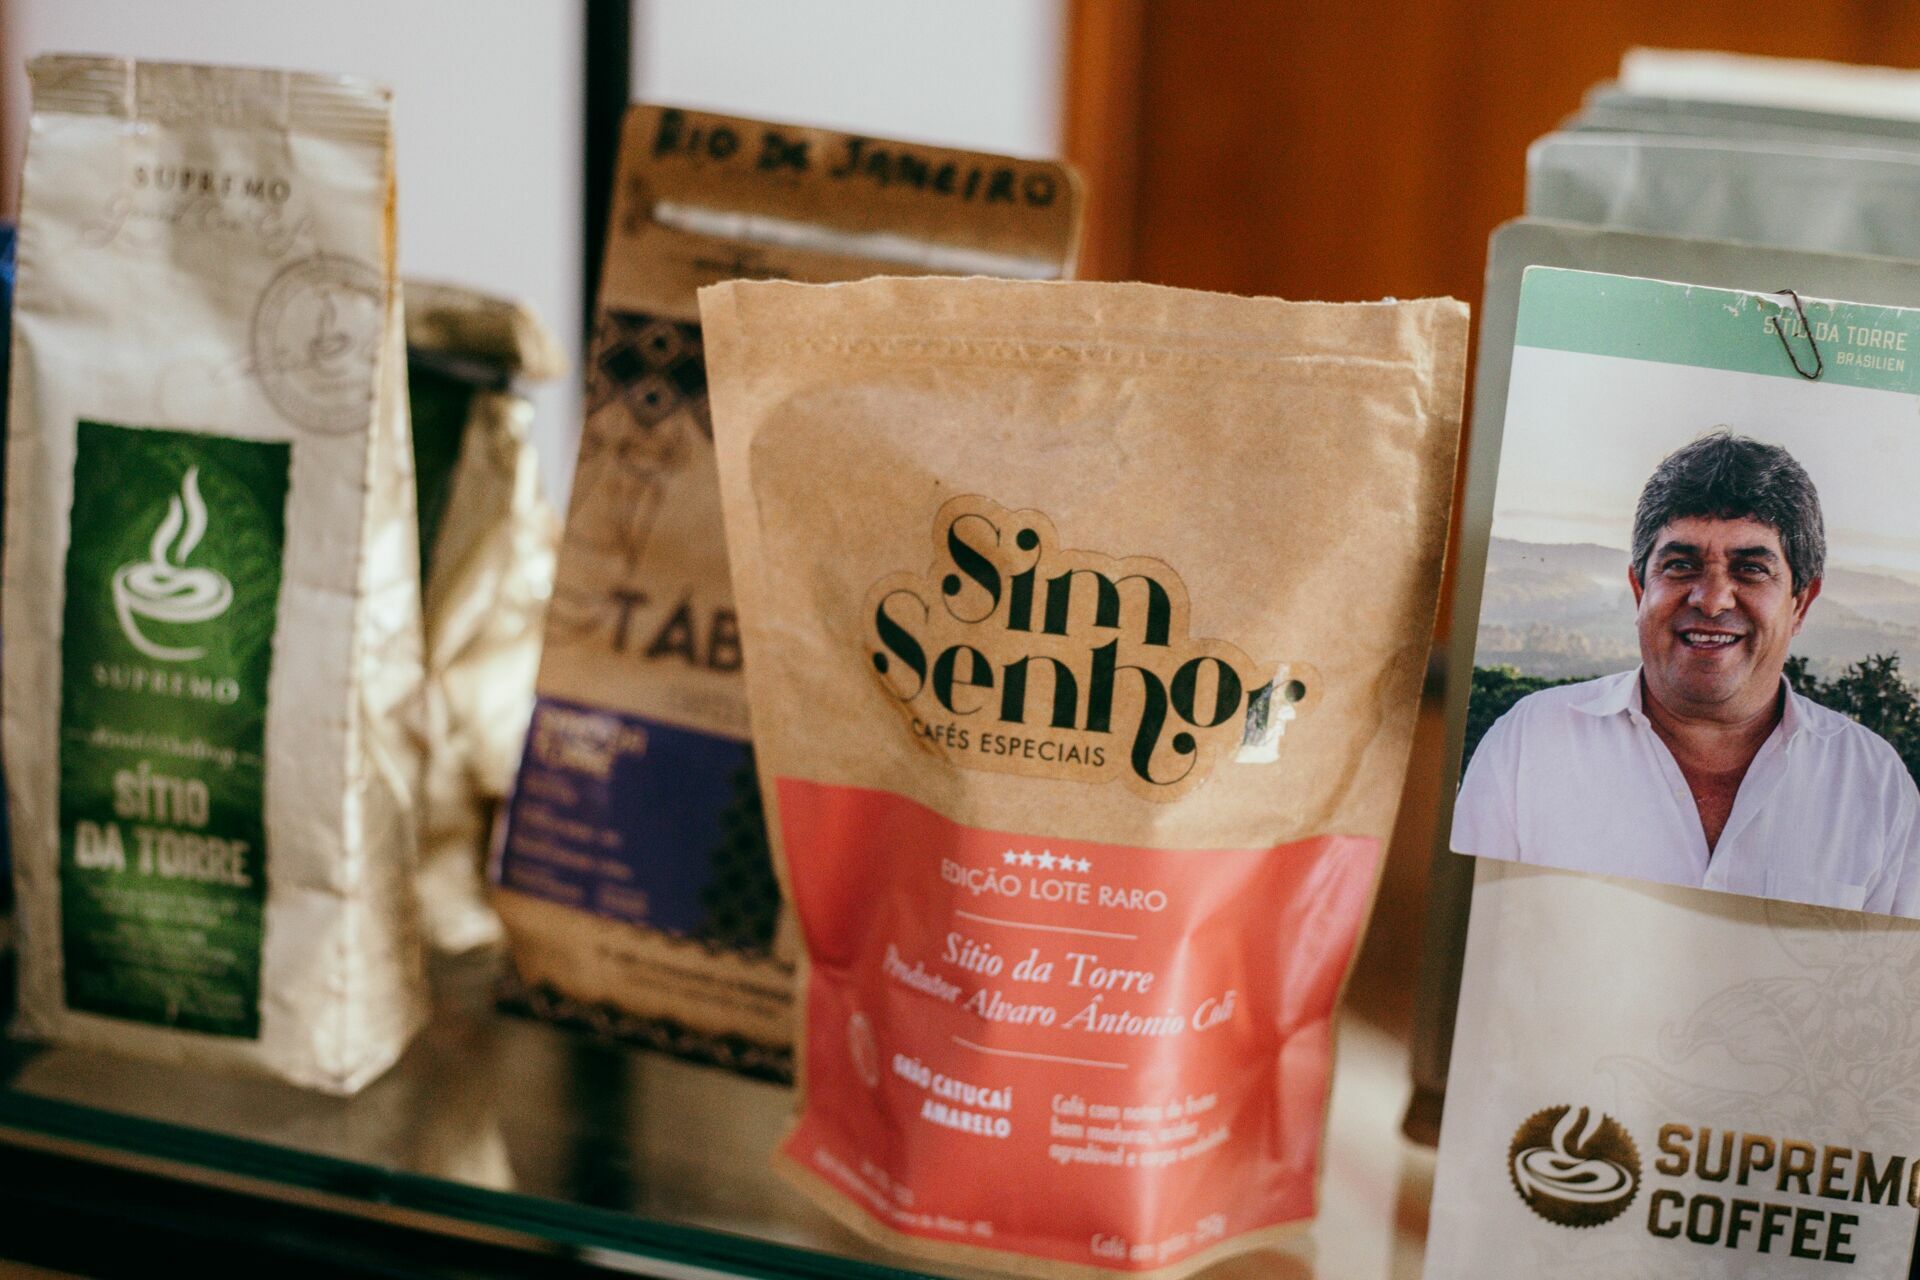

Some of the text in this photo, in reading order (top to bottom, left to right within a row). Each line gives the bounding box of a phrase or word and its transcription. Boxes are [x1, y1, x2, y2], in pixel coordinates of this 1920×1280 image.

[132, 166, 291, 205] SUPREMO
[1815, 321, 1840, 343] DA
[1847, 325, 1909, 352] TORRE
[1836, 351, 1906, 373] BRASILIEN
[942, 513, 1172, 647] Sim
[872, 589, 1306, 786] Senhor
[911, 718, 1106, 767] CAFÉS ESPECIAIS
[74, 820, 126, 872] DA
[940, 858, 1169, 913] EDIÇÃO LOTE RARO
[1011, 948, 1055, 984] da
[1065, 950, 1155, 995] Torre
[920, 1098, 1012, 1139] AMARELO
[1646, 1187, 1860, 1265] COFFEE
